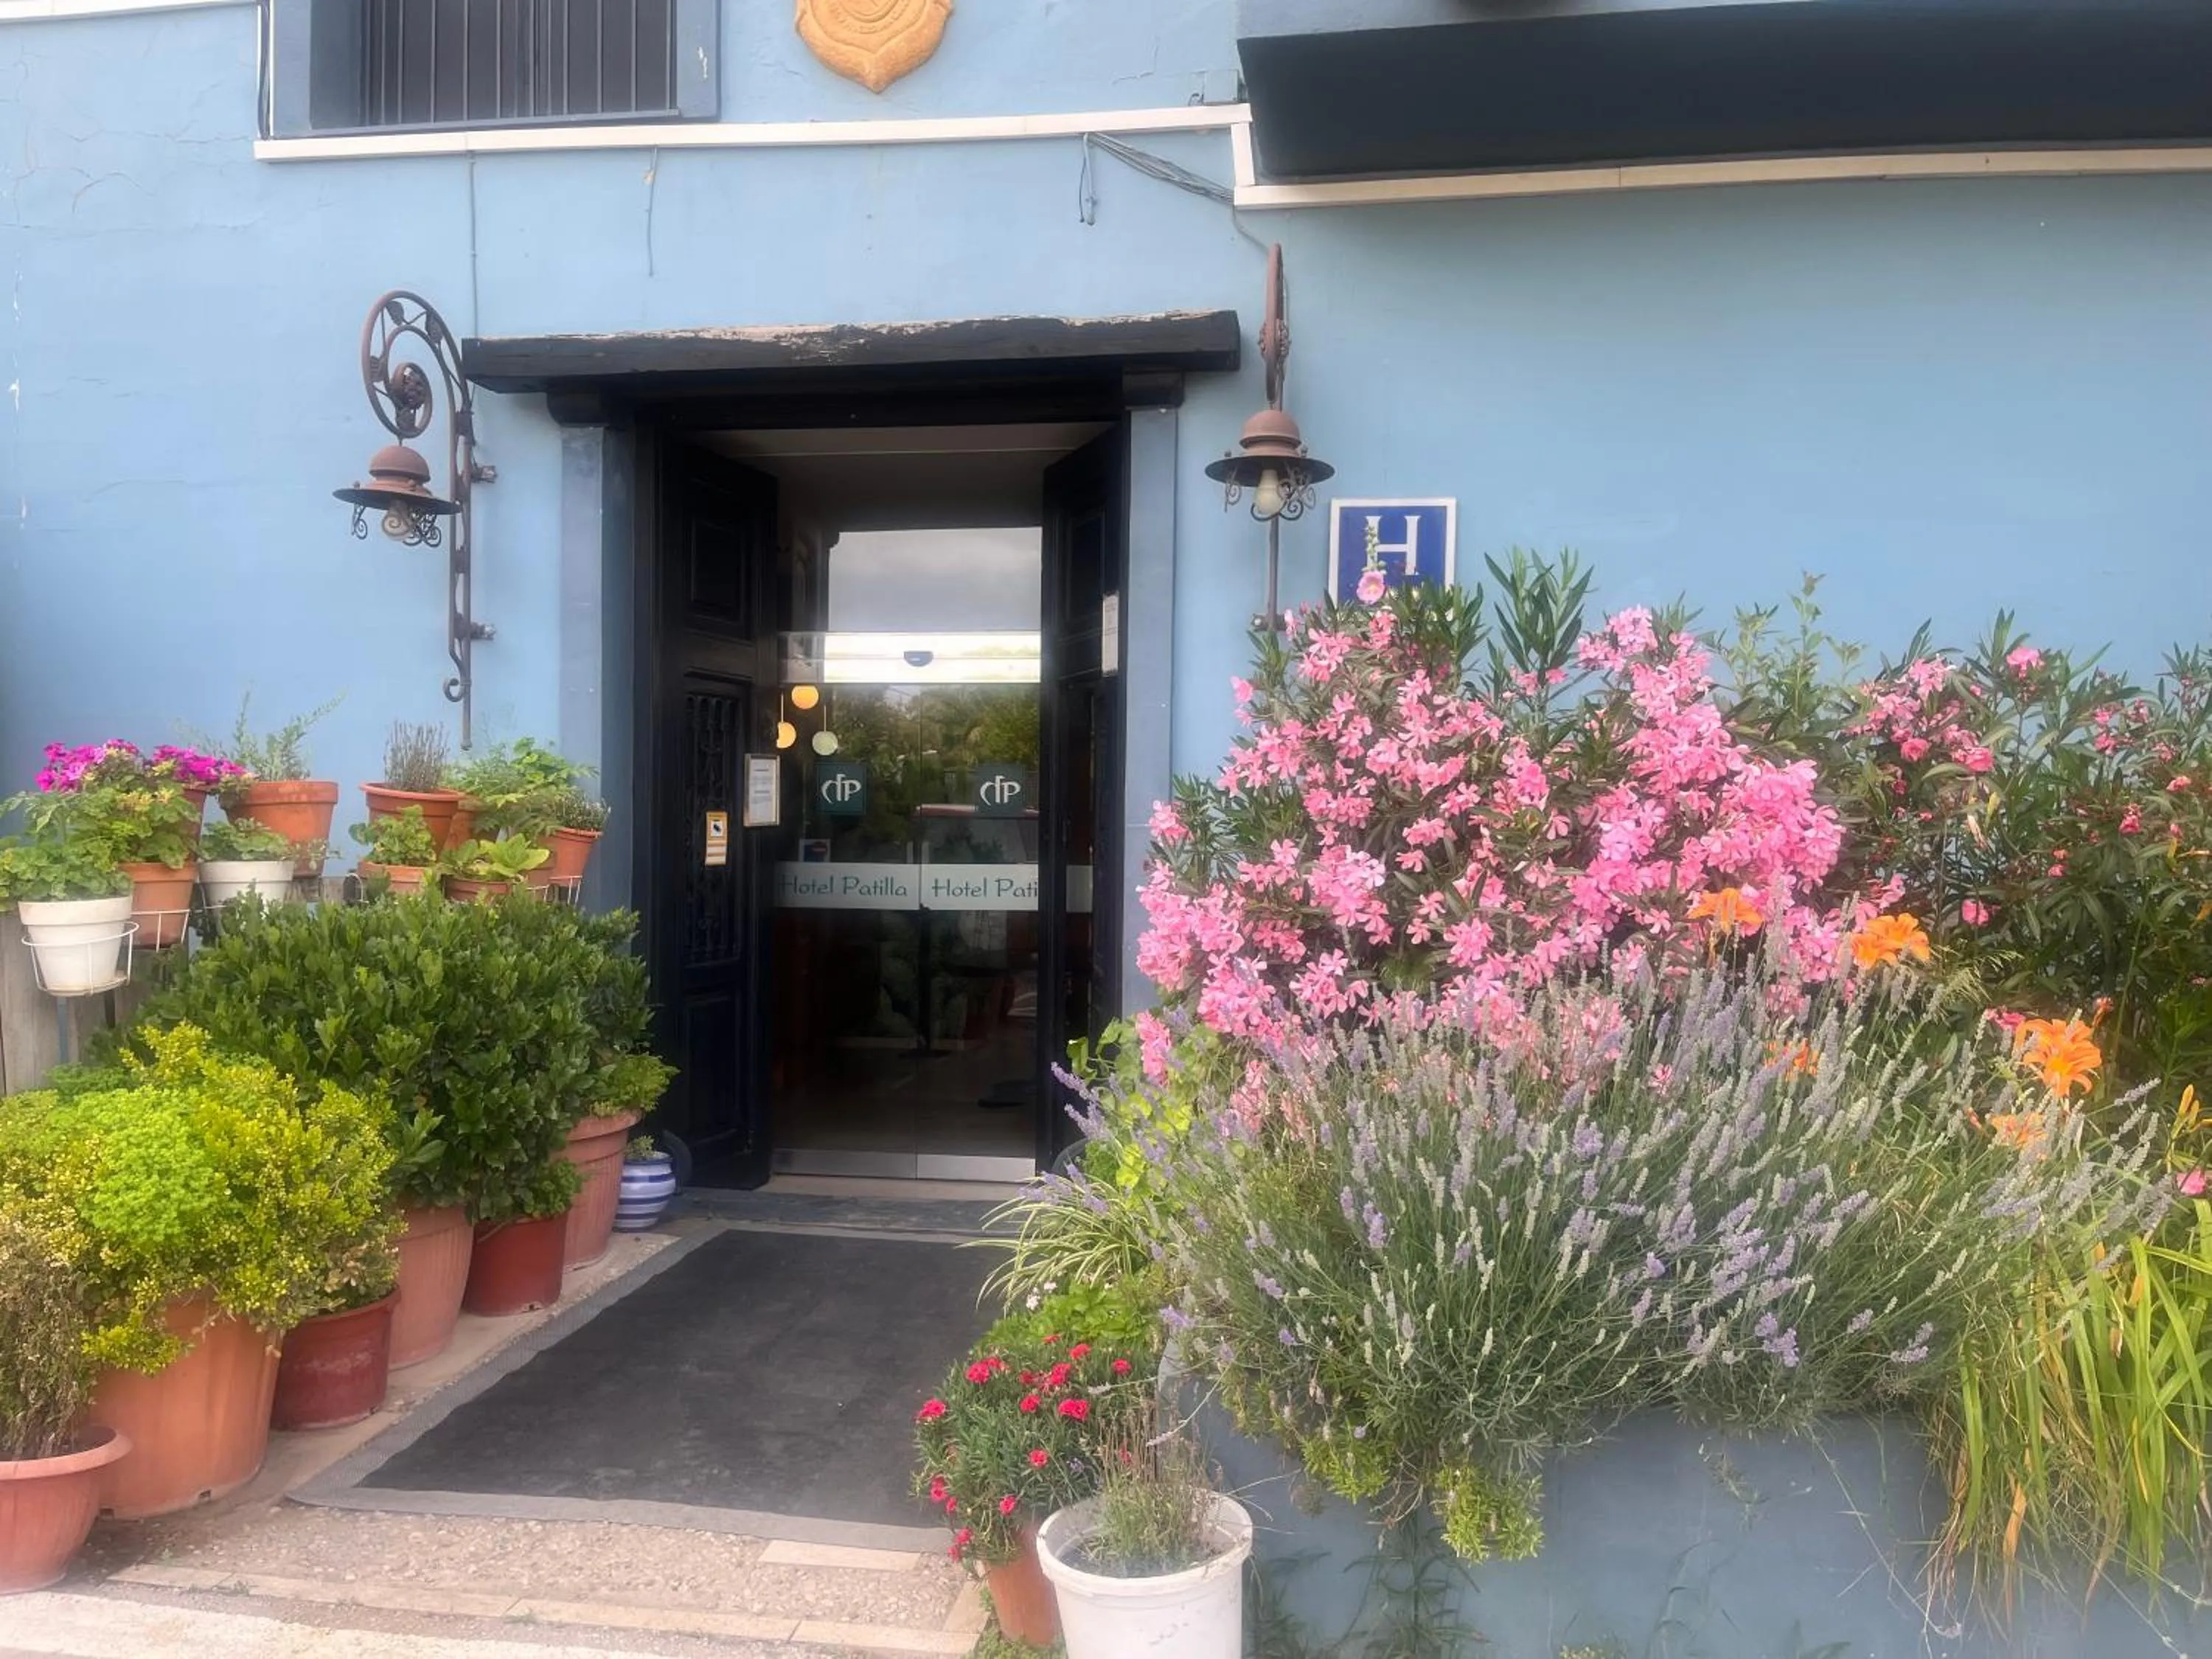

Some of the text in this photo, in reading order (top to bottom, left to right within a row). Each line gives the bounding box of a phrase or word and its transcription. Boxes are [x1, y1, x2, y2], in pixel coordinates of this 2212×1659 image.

[1364, 515, 1422, 576] H
[779, 874, 908, 897] Hotel Patilla
[931, 877, 988, 898] Hotel
